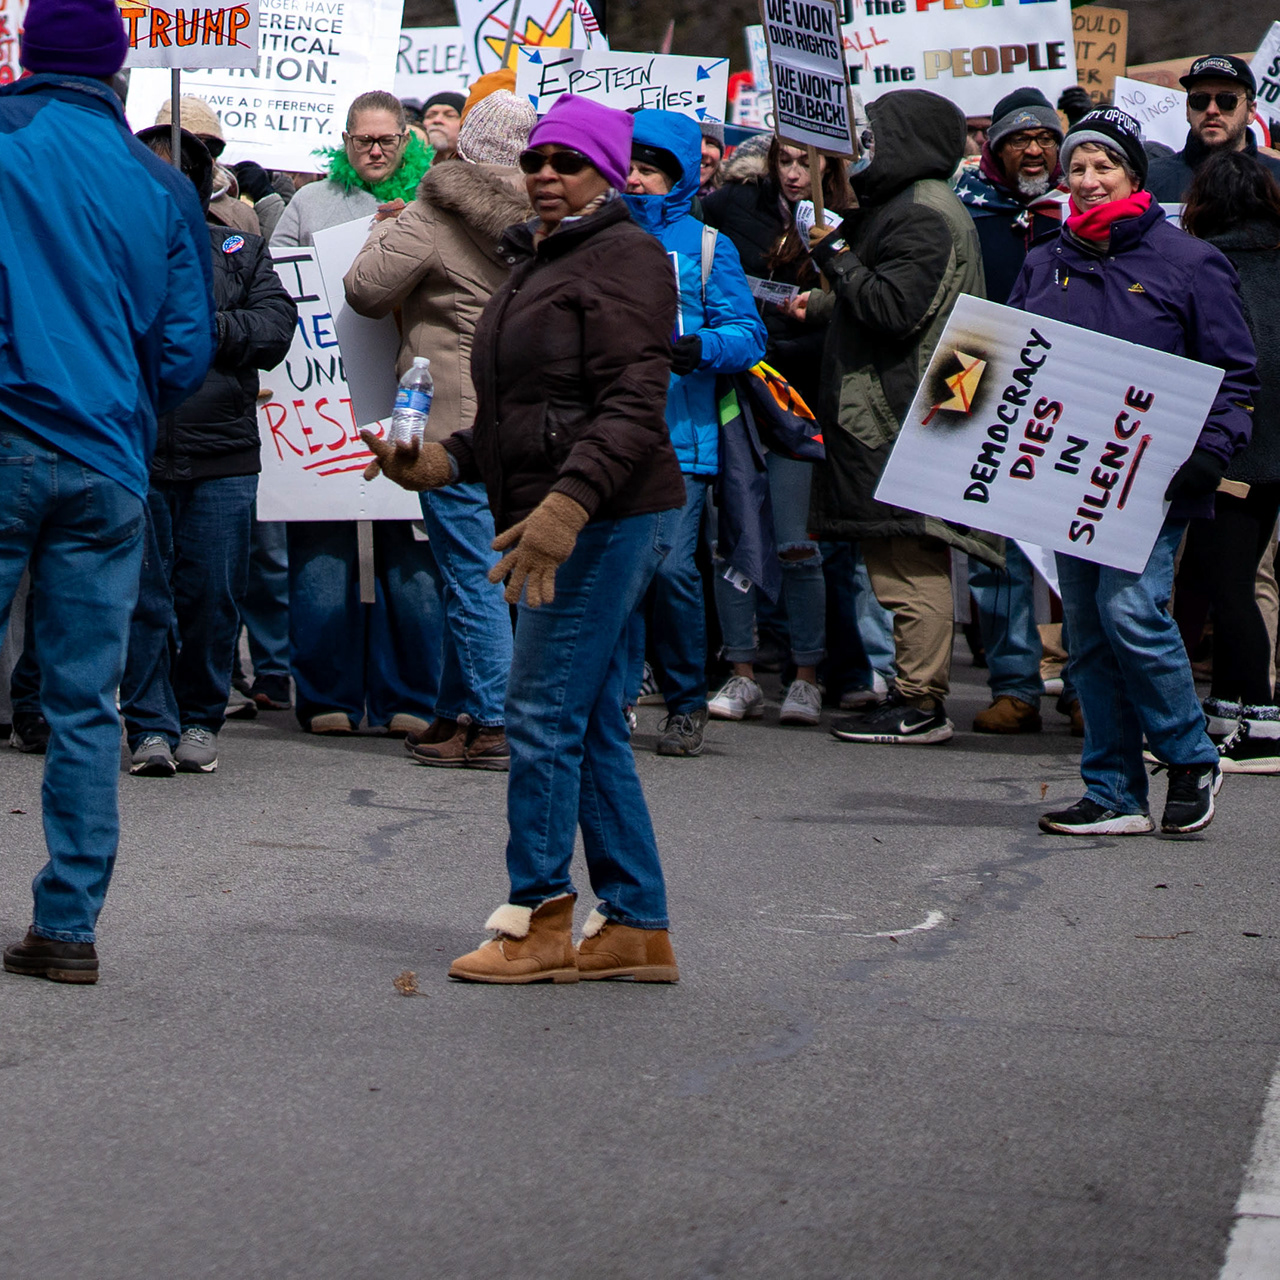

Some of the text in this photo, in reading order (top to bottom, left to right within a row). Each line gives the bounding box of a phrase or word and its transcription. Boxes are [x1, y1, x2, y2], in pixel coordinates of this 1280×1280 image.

[259, 13, 343, 36] ERENCE
[305, 1, 344, 16] HAVE
[793, 1, 834, 37] WON
[120, 7, 251, 49] TRUMP
[262, 34, 340, 56] ITICAL
[769, 25, 795, 48] OUR
[795, 32, 838, 60] RIGHTS
[842, 27, 889, 52] ALL
[538, 58, 655, 96] EPSTEIN
[874, 64, 916, 82] the
[923, 41, 1067, 80] PEOPLE
[238, 98, 248, 107] A
[775, 64, 797, 92] WE
[798, 71, 844, 105] WON'T
[1121, 90, 1146, 108] NO
[777, 89, 795, 114] GO
[805, 97, 847, 127] BACK!
[261, 398, 385, 461] RESI
[963, 328, 1052, 504] DEMOCRACY
[1009, 396, 1064, 480] DIES
[1054, 434, 1089, 475] IN
[1068, 385, 1155, 545] SILENCE
